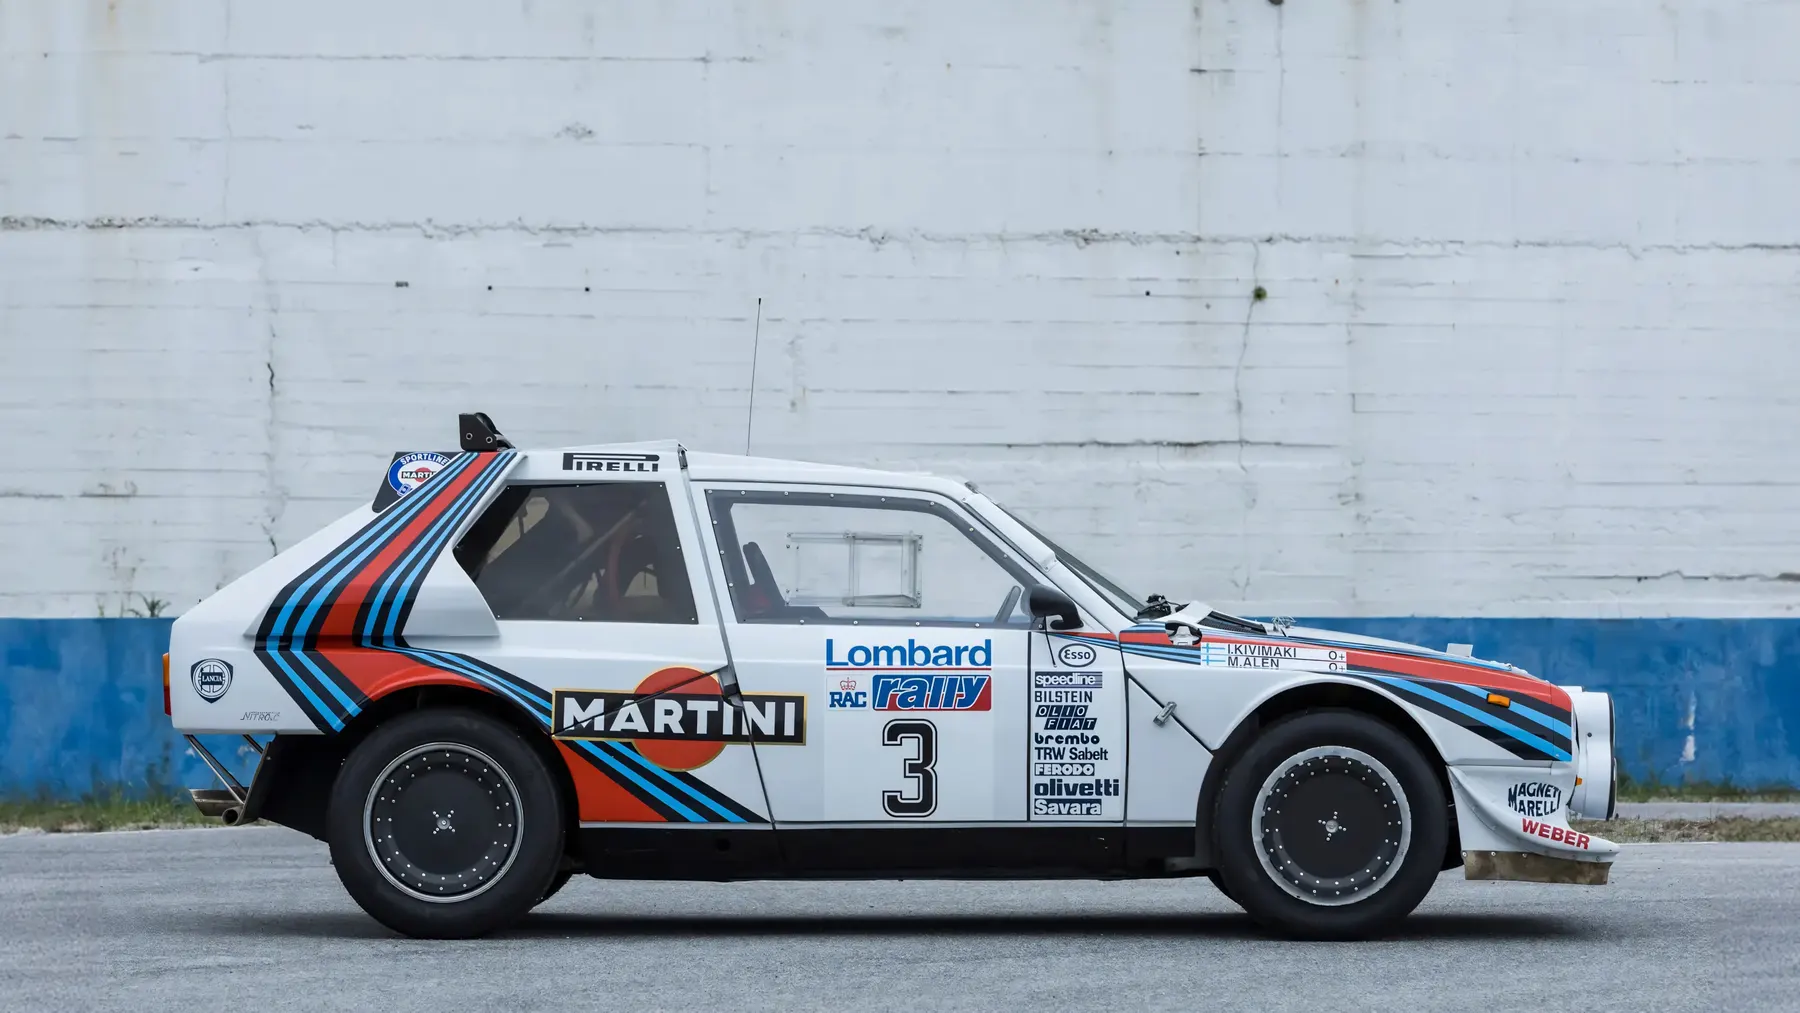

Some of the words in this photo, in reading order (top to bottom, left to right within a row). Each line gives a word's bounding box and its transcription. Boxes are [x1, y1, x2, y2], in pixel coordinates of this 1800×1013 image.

[400, 453, 449, 466] SPORTLINE
[562, 453, 660, 472] PIRELLI
[402, 471, 434, 479] MARTI
[826, 639, 992, 666] Lombard
[1063, 649, 1091, 660] Esso
[1227, 643, 1297, 658] I.KIVIMAKI
[1227, 656, 1280, 668] M.ALEN
[202, 675, 223, 683] LANCIA
[1035, 672, 1096, 687] speedline
[829, 691, 867, 708] RAC
[874, 676, 990, 710] rally
[1034, 690, 1093, 703] BILSTEIN
[562, 697, 796, 736] MARTINI
[1038, 706, 1086, 716] OLIO
[1047, 719, 1095, 729] FIAT
[1034, 732, 1100, 745] brembo
[1034, 747, 1066, 760] TRW
[1069, 747, 1108, 760] Sabelt
[882, 719, 938, 818] 3
[1035, 763, 1094, 775] FERODO
[1034, 778, 1119, 796] olivetti
[1034, 799, 1102, 815] Savara
[1508, 797, 1561, 816] MARELLI
[1522, 818, 1590, 850] WEBER
